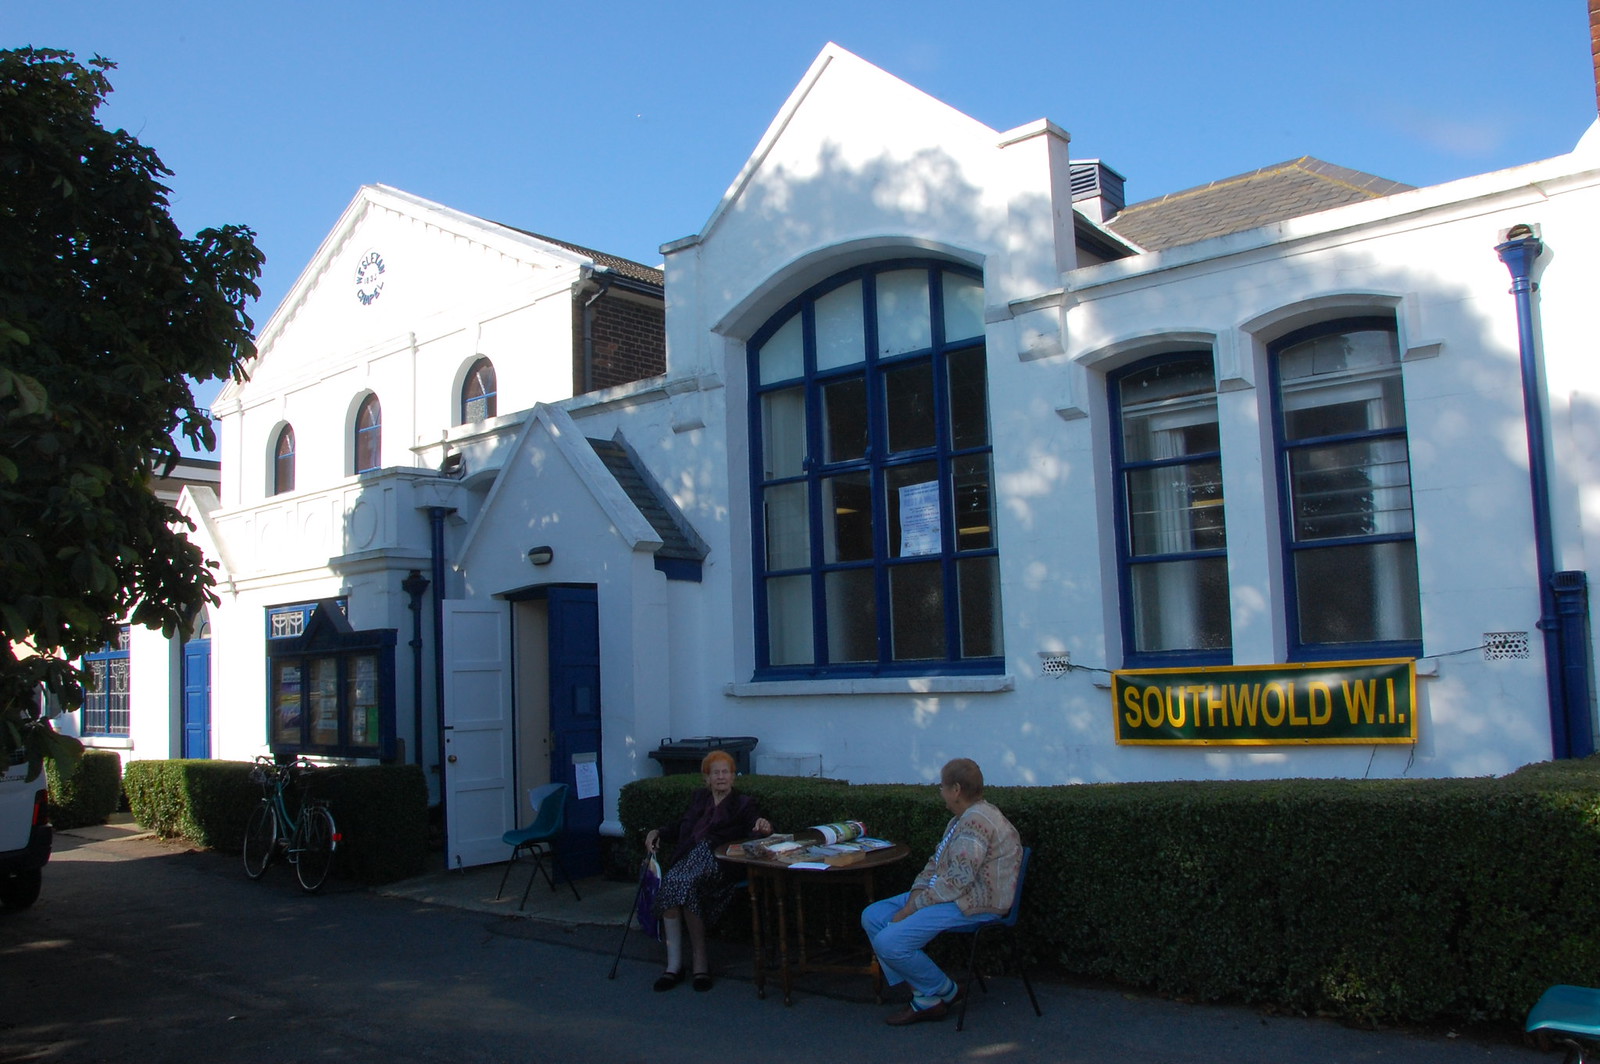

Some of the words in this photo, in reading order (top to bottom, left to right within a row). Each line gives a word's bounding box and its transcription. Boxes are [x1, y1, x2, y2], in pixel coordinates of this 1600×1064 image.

[356, 252, 385, 285] WESLEYAN
[357, 281, 385, 305] CHAPEL
[1124, 682, 1332, 728] SOUTHWOLD
[1342, 678, 1405, 724] W.I.
